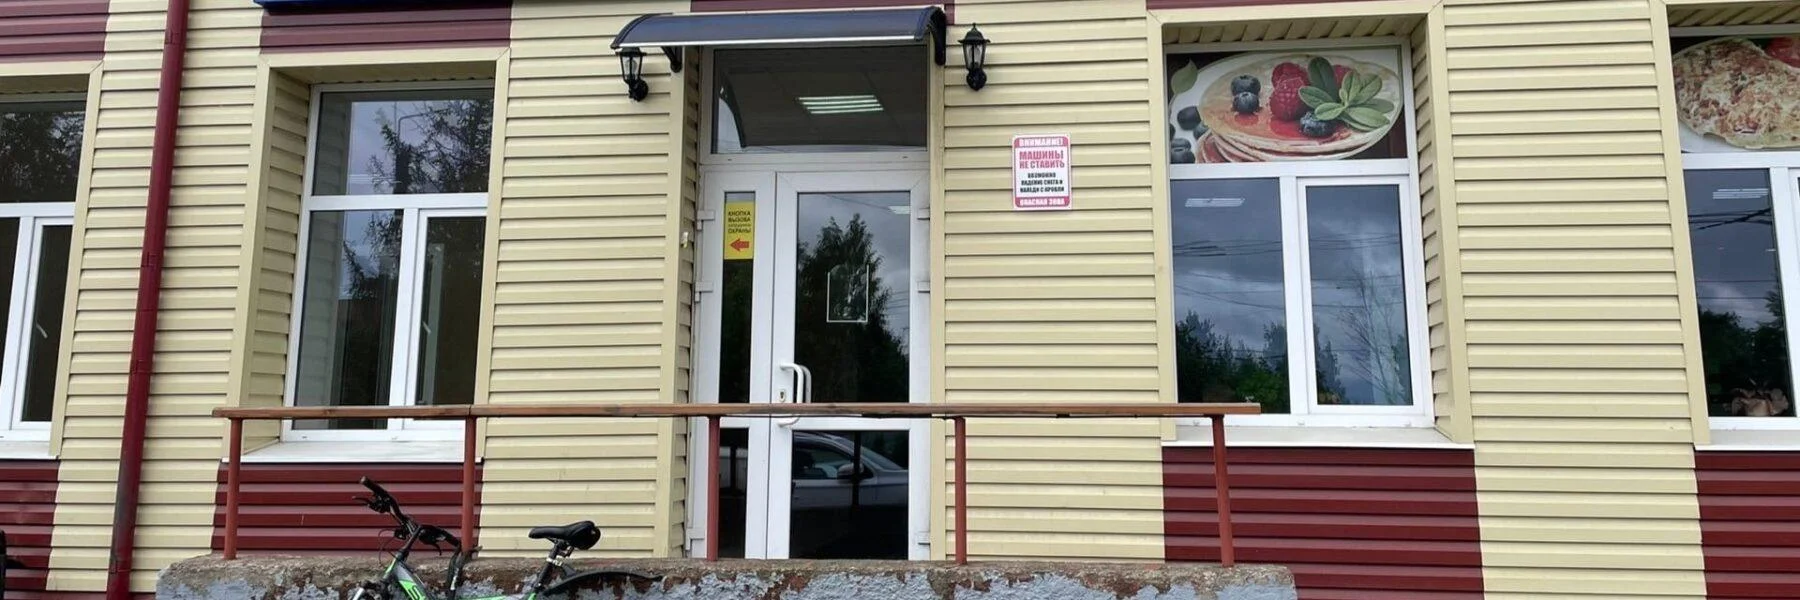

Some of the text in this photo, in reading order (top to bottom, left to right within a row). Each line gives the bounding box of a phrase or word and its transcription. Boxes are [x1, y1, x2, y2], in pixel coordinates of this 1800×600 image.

[1019, 138, 1063, 147] ВНИМАНИЕ!
[1019, 150, 1064, 160] МАШИНЫ
[1019, 160, 1065, 169] НЕ СТАВИТЬ
[1019, 198, 1065, 206] ОПАСНАЯ ЗОНА
